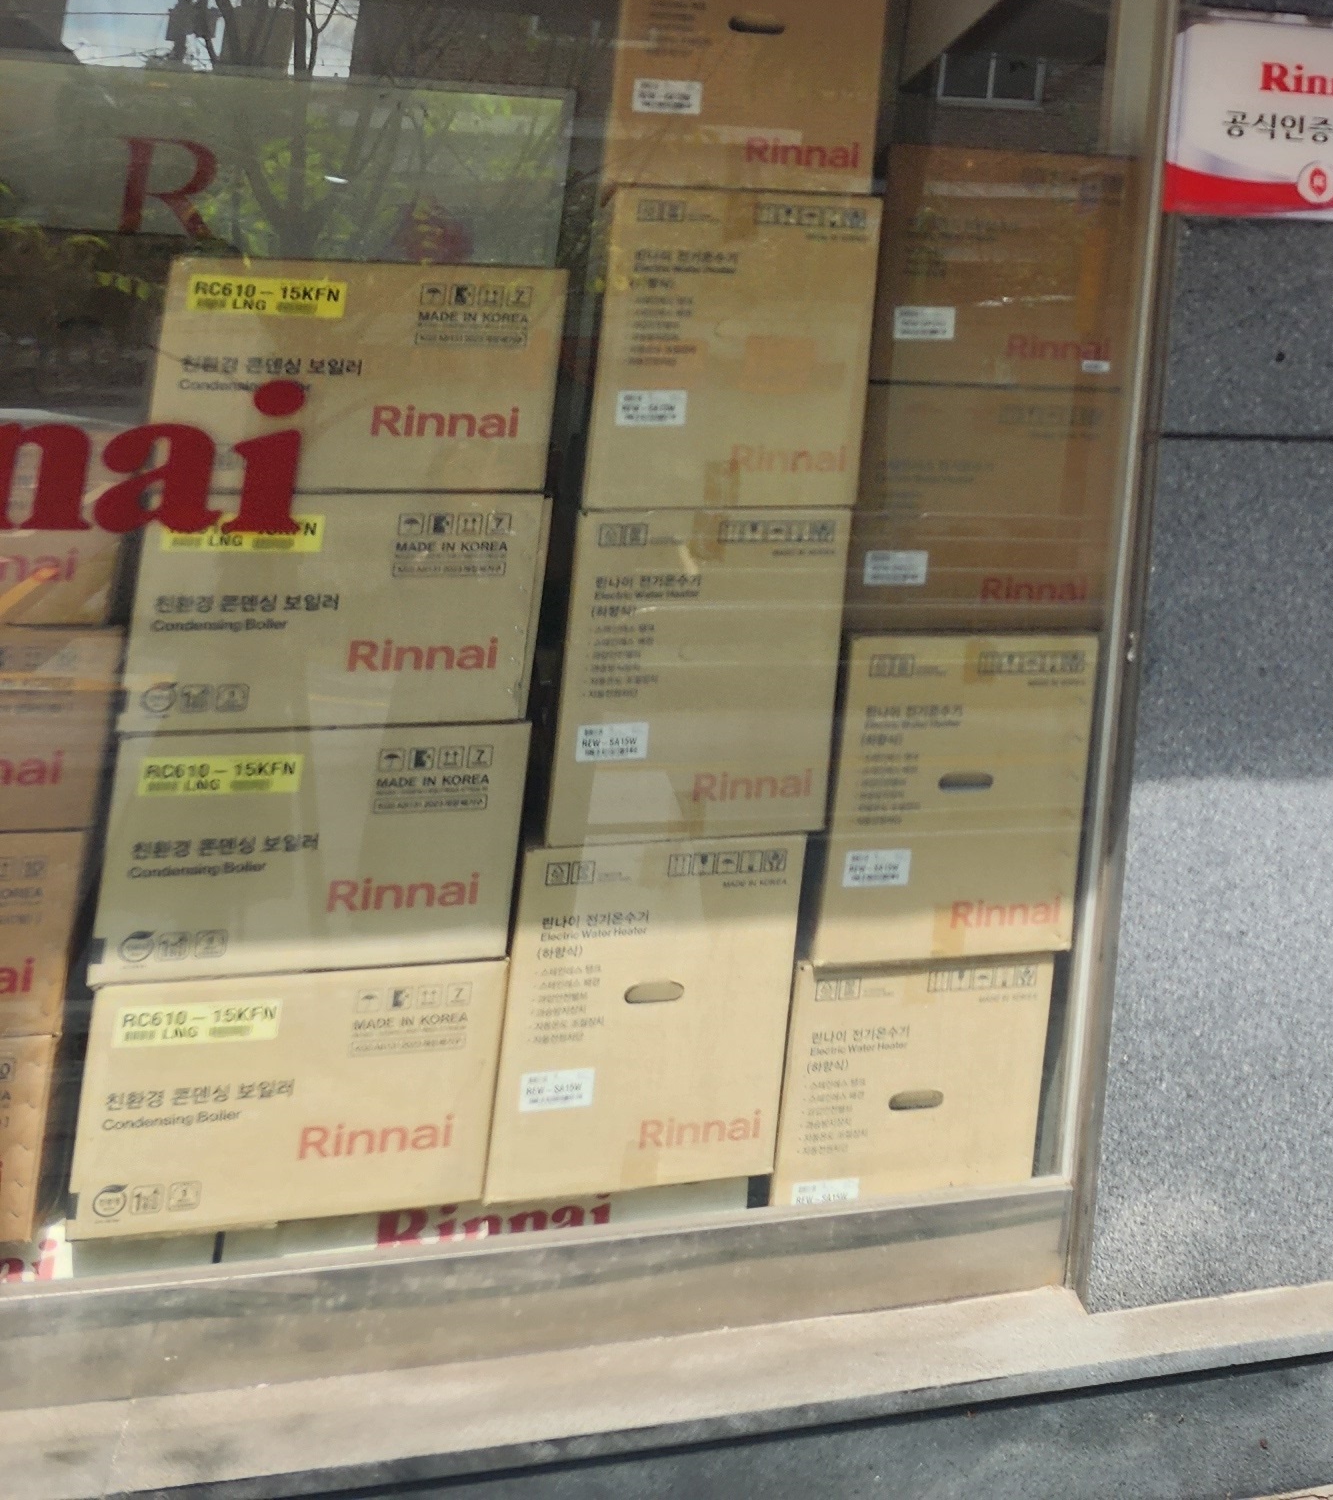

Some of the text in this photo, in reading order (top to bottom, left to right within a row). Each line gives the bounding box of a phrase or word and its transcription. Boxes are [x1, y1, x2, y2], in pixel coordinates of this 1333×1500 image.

[745, 136, 860, 168] Rinnai
[281, 286, 340, 301] 15KFN
[232, 300, 266, 310] LNG
[418, 311, 528, 323] MADE IN KOREA
[307, 358, 362, 375] 보일러
[370, 404, 520, 438] Rinnai
[208, 535, 243, 547] LNG
[395, 541, 508, 551] MADE IN KOREA
[980, 576, 1088, 602] Rinnai
[284, 593, 339, 611] 보일러
[346, 636, 498, 672] Rinnai
[234, 761, 296, 777] 15KFN
[184, 779, 220, 791] LNG
[376, 774, 489, 788] MADE IN KOREA
[693, 768, 813, 803] Rinnai
[263, 832, 319, 853] 보일러
[326, 871, 480, 913] Rinnai
[951, 894, 1061, 930] Rinnai
[540, 926, 648, 943] Electric Water Heater
[123, 1006, 277, 1027] RC610 15KFN
[354, 1012, 468, 1030] MADE IN KOREA
[163, 1027, 199, 1040] LNG
[848, 1043, 876, 1053] Water
[877, 1041, 908, 1051] Heater
[106, 1078, 295, 1111] 친환경 콘덴싱 보일러
[102, 1110, 242, 1130] Condensing Boiler
[639, 1108, 761, 1149] Rinnai
[297, 1113, 455, 1159] Rinnai
